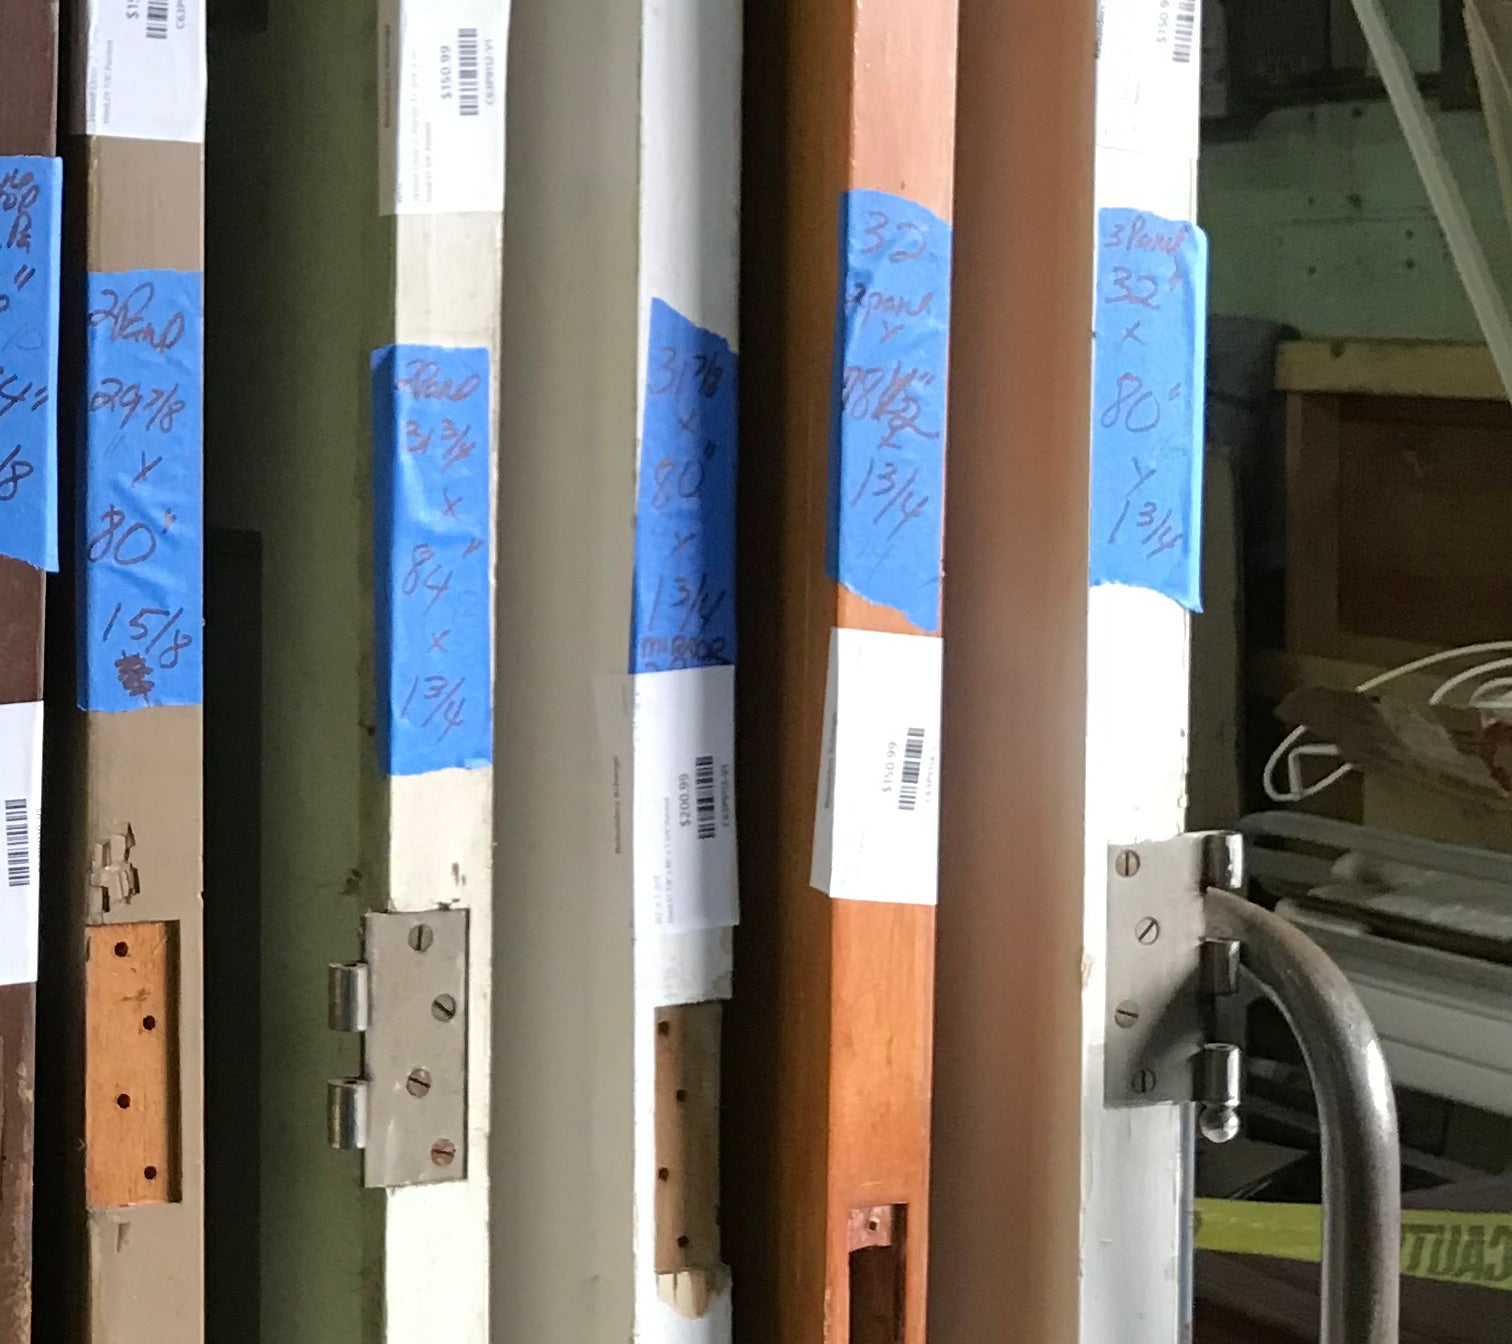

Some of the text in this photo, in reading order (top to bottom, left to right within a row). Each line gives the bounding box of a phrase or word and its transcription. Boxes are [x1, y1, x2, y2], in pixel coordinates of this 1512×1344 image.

[440, 46, 452, 99] $150.99
[860, 211, 927, 264] 32
[1103, 224, 1125, 247] 3
[88, 288, 119, 327] 2
[88, 377, 143, 429] 29
[441, 417, 476, 474] 3/4
[872, 462, 929, 536] 3/4
[1137, 502, 1184, 558] 3/4
[128, 606, 193, 670] 5/8
[422, 675, 466, 742] 3/4
[678, 772, 691, 828] $200.99
